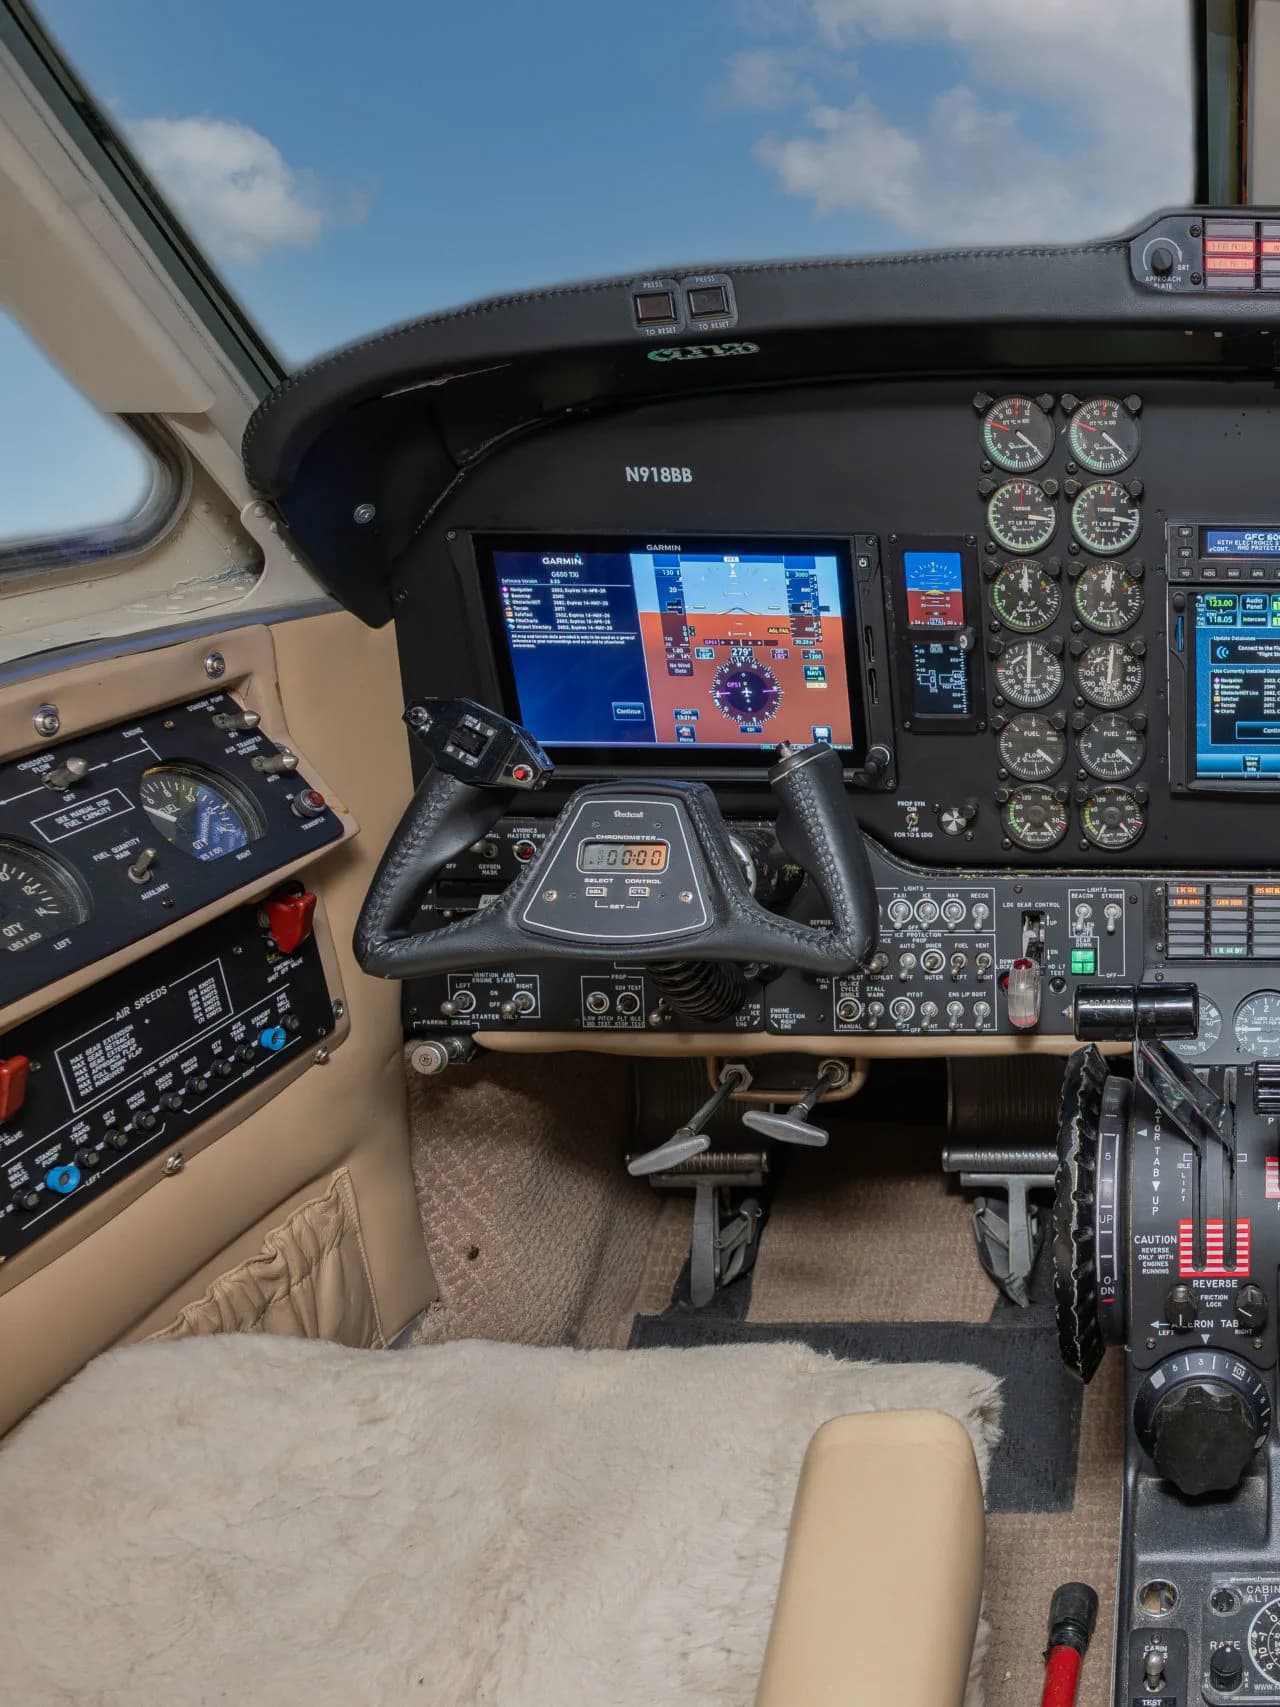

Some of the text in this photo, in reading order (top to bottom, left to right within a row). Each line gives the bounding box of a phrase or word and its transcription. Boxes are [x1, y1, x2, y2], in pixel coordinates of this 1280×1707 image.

[625, 466, 693, 483] N918BB
[1244, 533, 1265, 541] GFC
[646, 544, 681, 552] GARMIN
[542, 557, 582, 566] GARMIN
[1209, 599, 1233, 607] 123.00
[616, 706, 642, 715] Continue
[2, 922, 24, 937] QTY
[53, 937, 72, 951] LEFT
[114, 985, 168, 1022] AIR SPEEDS
[85, 1173, 101, 1186] LEFT
[1100, 1215, 1113, 1224] UP
[1134, 1236, 1177, 1244] CAUTION
[1192, 1280, 1238, 1288] REVERSE
[1100, 1286, 1115, 1295] DN
[1221, 1319, 1239, 1328] TAB
[1247, 1595, 1269, 1603] ALT
[1209, 1641, 1241, 1650] RATE
